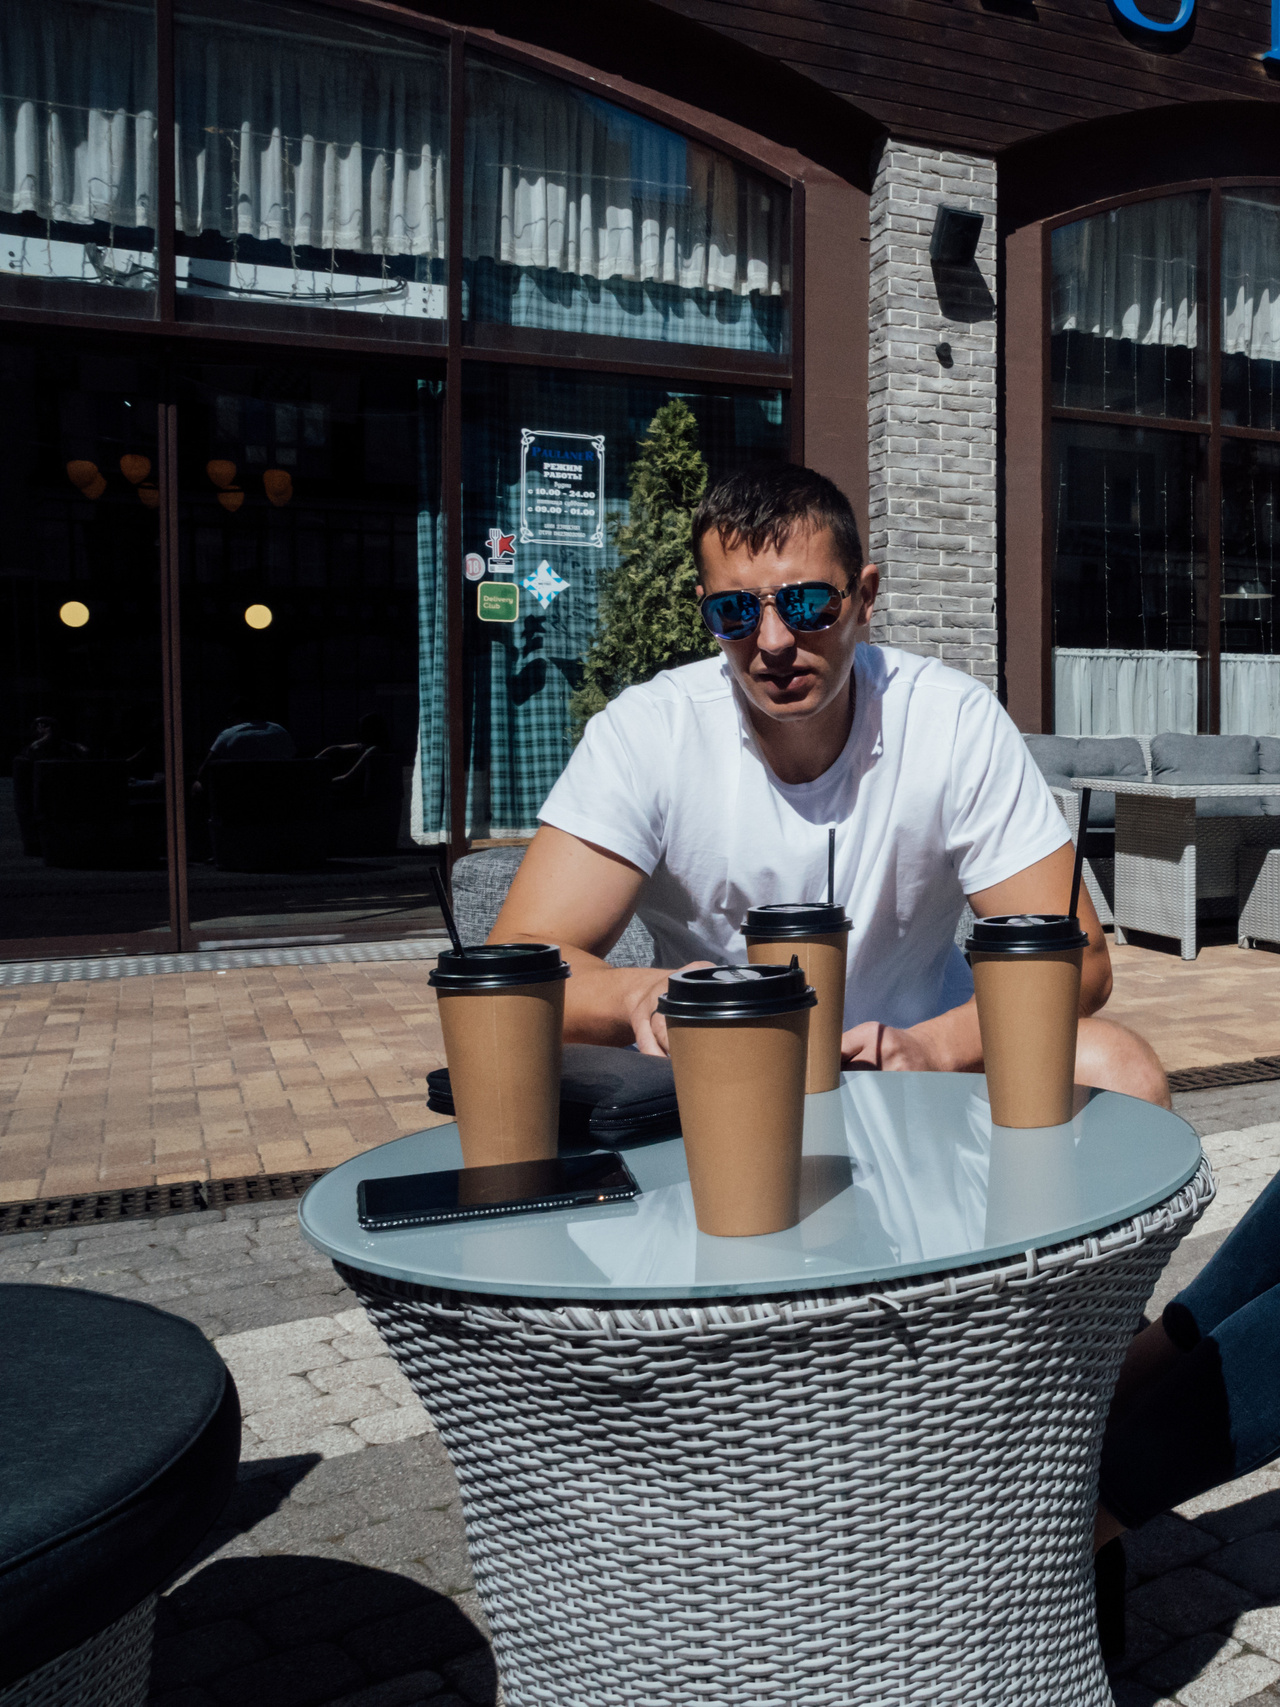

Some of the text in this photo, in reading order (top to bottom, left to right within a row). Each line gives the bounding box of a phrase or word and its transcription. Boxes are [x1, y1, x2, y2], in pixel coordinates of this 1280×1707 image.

[543, 462, 583, 472] РЕЖИМ
[543, 472, 583, 480] РАБОТЫ
[535, 488, 561, 496] 10.00
[569, 490, 595, 498] 24.00
[535, 506, 562, 514] 09.00
[570, 508, 595, 516] 01.00
[483, 595, 514, 604] Delivery
